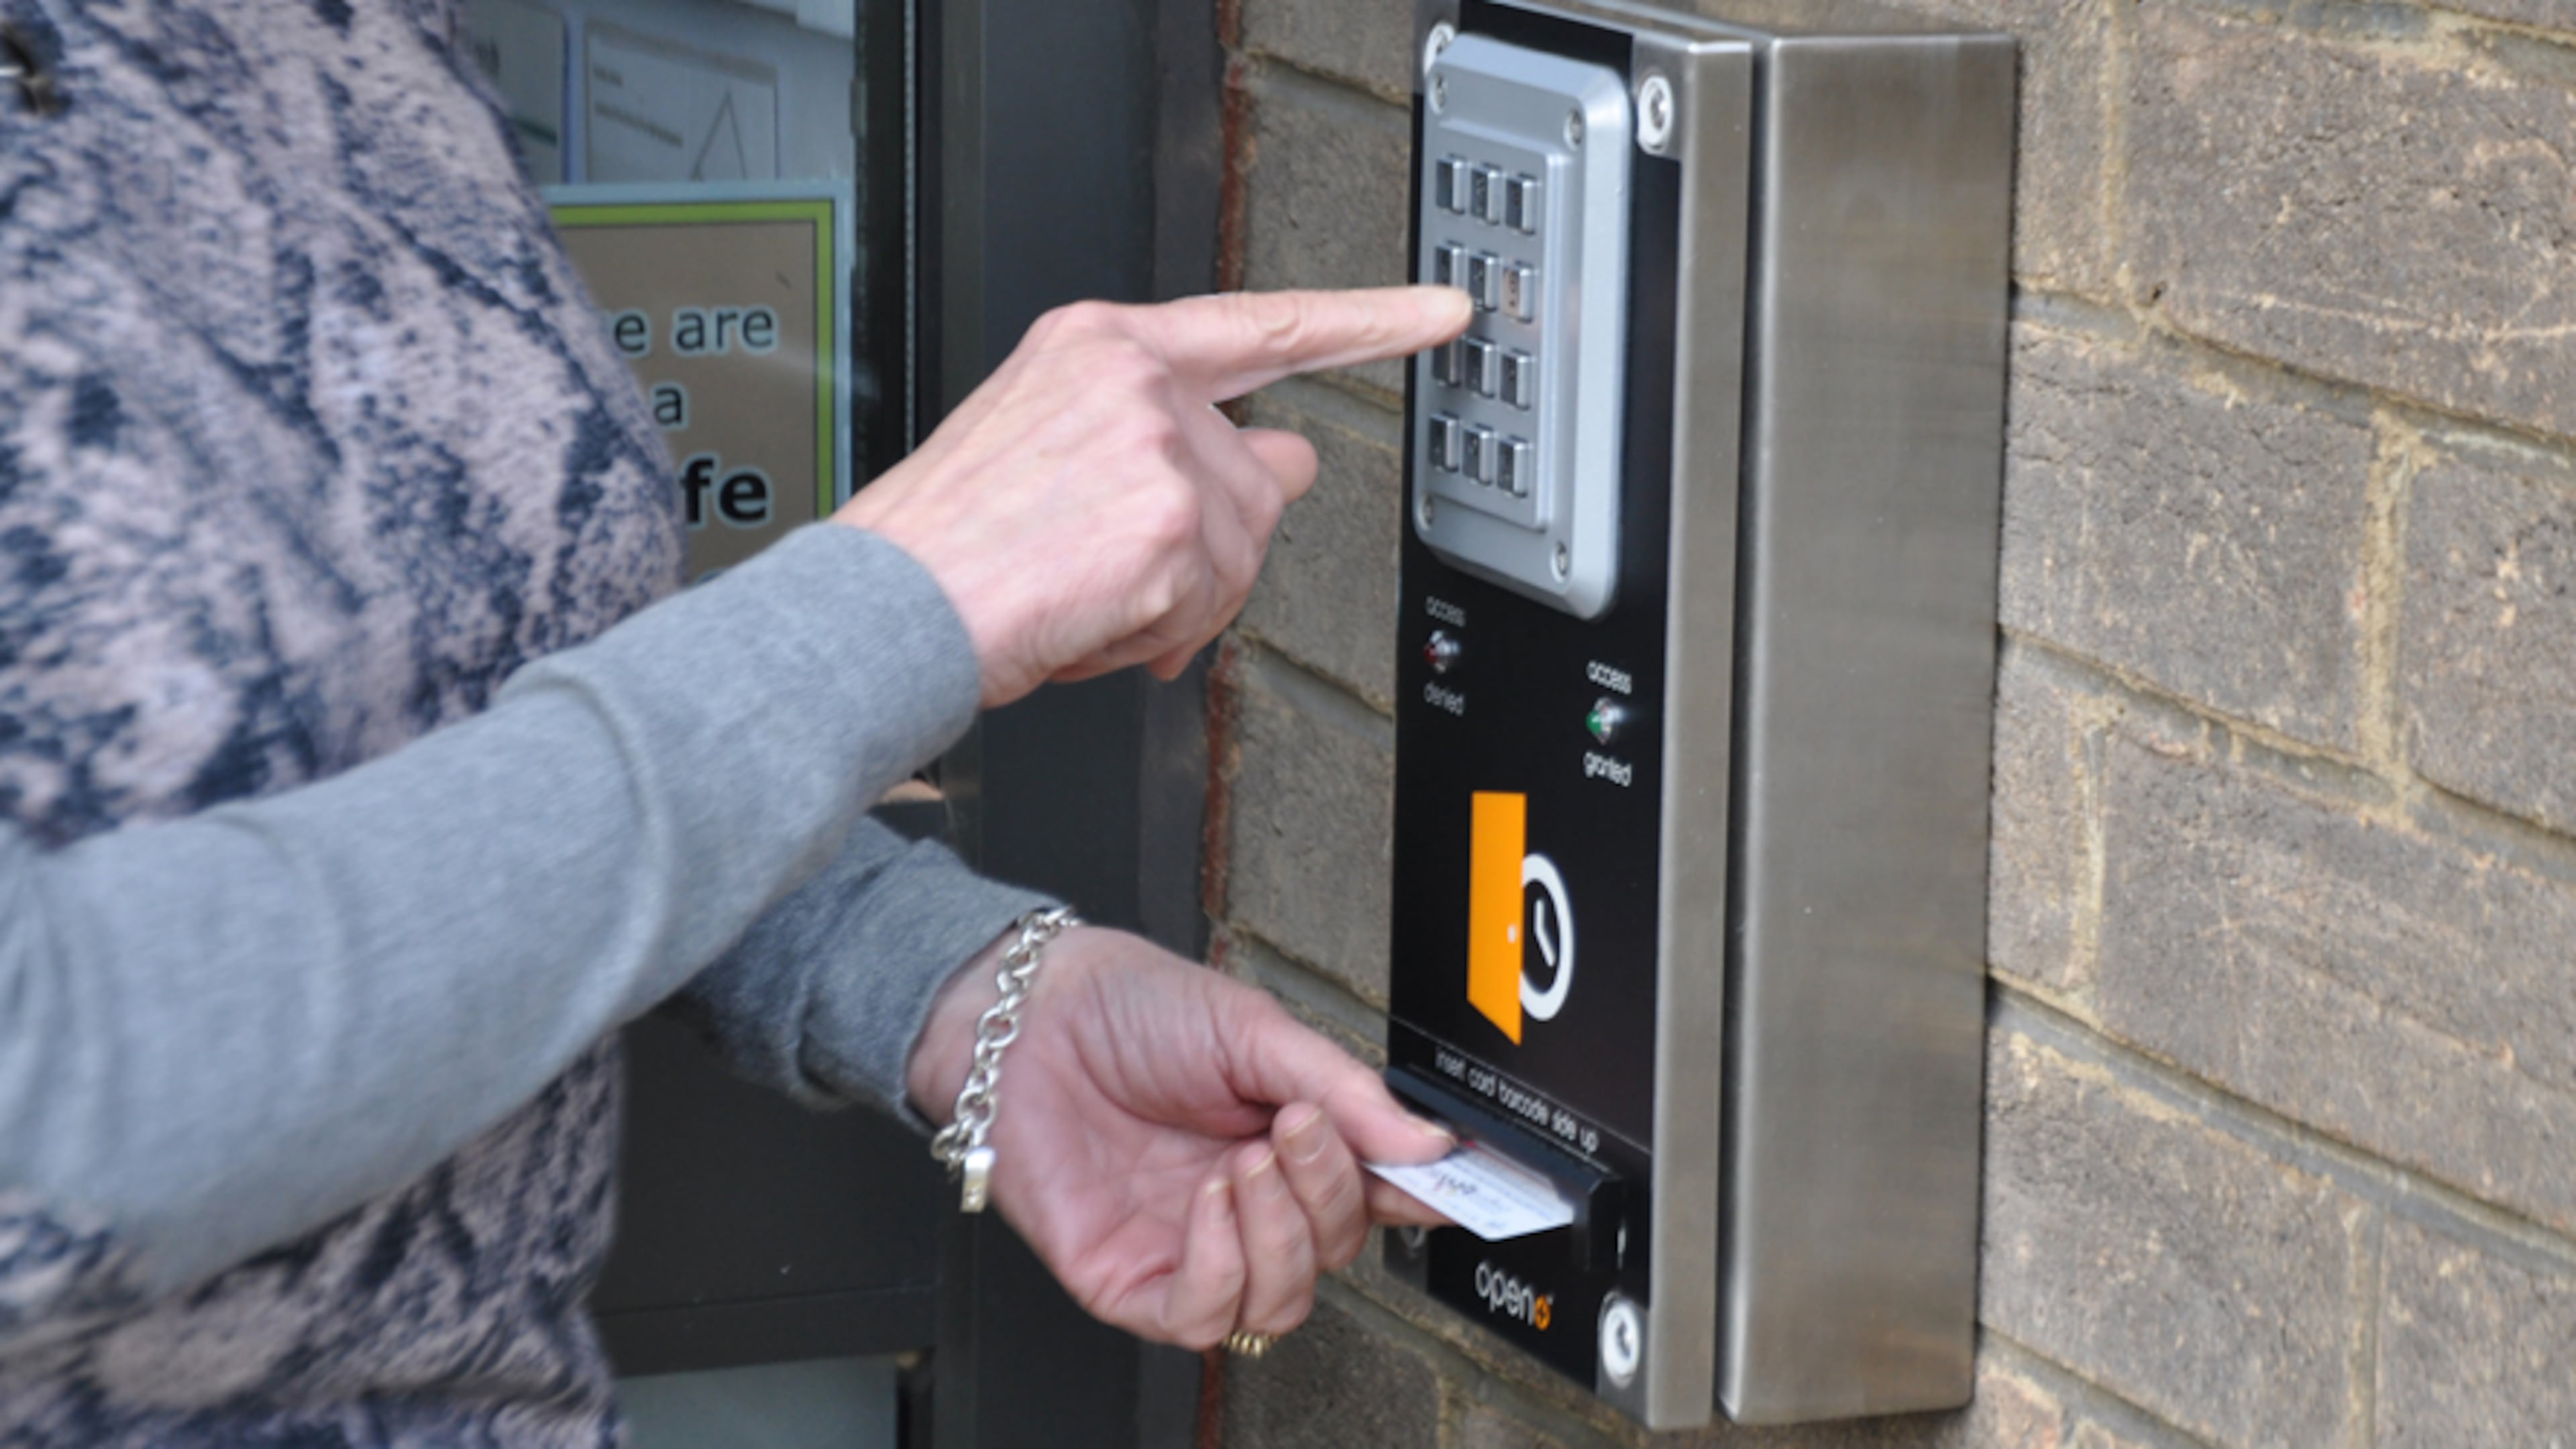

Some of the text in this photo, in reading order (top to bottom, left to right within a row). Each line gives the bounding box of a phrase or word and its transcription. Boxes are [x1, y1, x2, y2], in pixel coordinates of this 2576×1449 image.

[613, 309, 773, 354] e are
[680, 457, 767, 524] fe
[1426, 596, 1466, 628] access
[1586, 659, 1632, 695] access
[1424, 680, 1464, 716] denied
[1582, 750, 1632, 787] granted
[1435, 1046, 1599, 1155] insert card barcode side up
